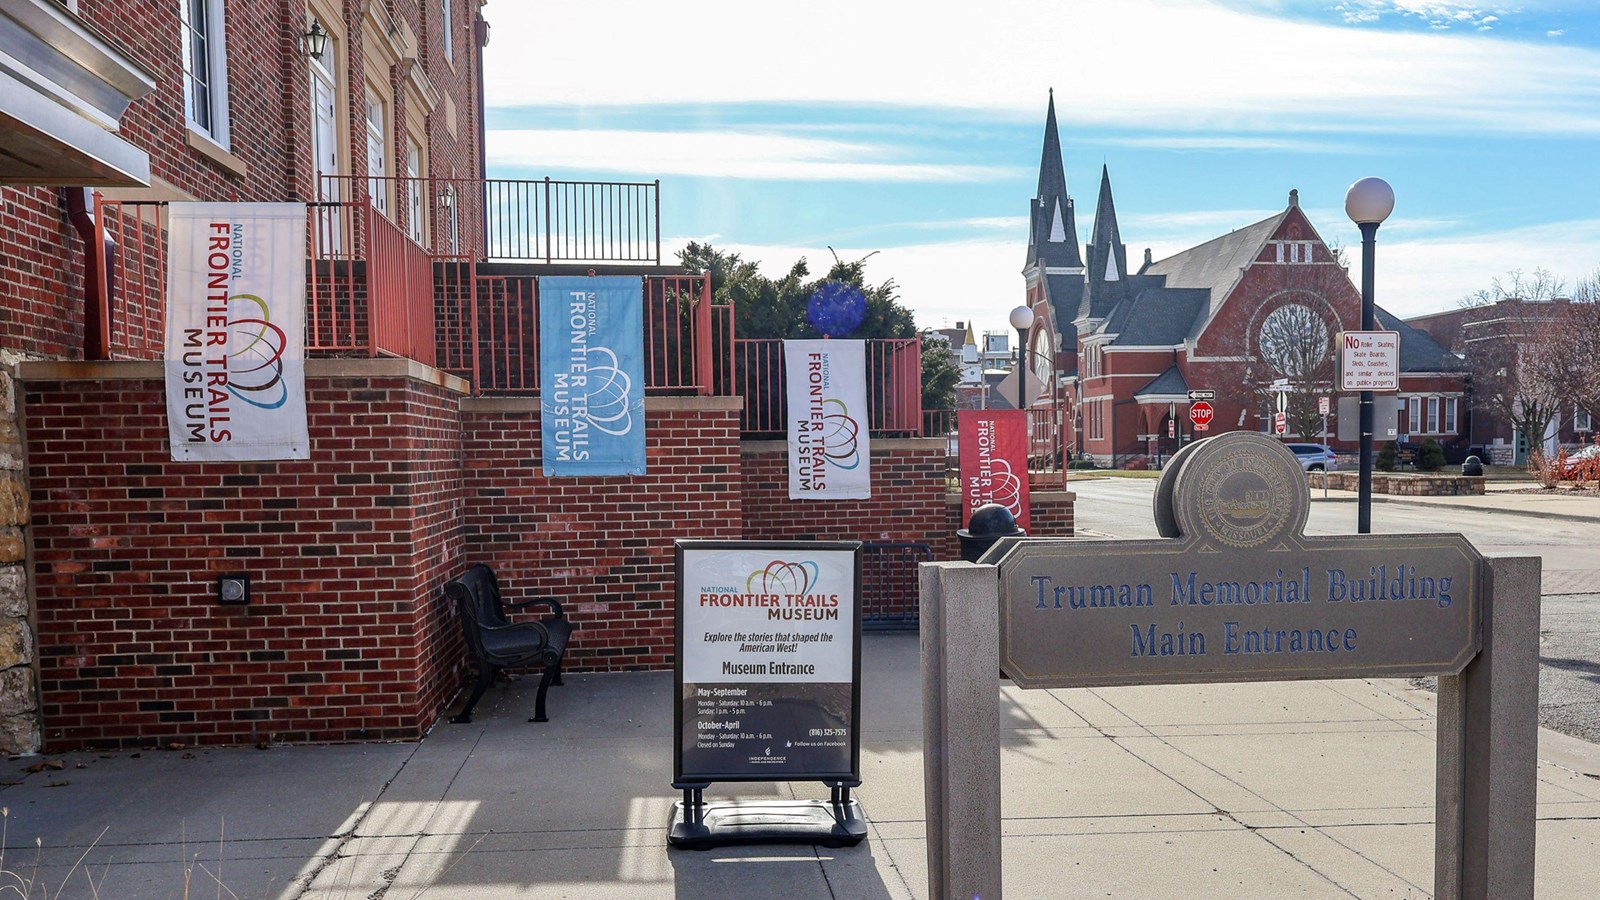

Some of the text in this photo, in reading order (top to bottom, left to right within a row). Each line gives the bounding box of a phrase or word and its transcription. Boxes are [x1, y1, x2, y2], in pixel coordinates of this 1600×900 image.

[232, 223, 243, 280] NATIONAL
[206, 223, 232, 443] FRONTIER TRAILS
[588, 292, 596, 337] NATIONAL
[183, 329, 206, 443] MUSEUM
[570, 291, 589, 461] FRONTIER TRAILS
[554, 373, 570, 461] MUSEUM
[809, 353, 826, 490] FRONTIER TRAILS
[1192, 409, 1212, 418] STOP
[798, 420, 811, 490] MUSEUM
[978, 421, 991, 487] FRONTIER
[1219, 525, 1268, 539] MISSOURI
[700, 594, 838, 607] FRONTIER TRAILS
[1029, 565, 1454, 611] Truman Memorial Building
[768, 609, 838, 620] MUSEUM
[704, 632, 833, 643] Explore the stories that shaped the
[739, 643, 798, 652] American West!
[1129, 621, 1358, 658] Main Entrance
[722, 662, 814, 675] Museum Entrance
[698, 688, 747, 697] May-September
[698, 721, 740, 730] October-April
